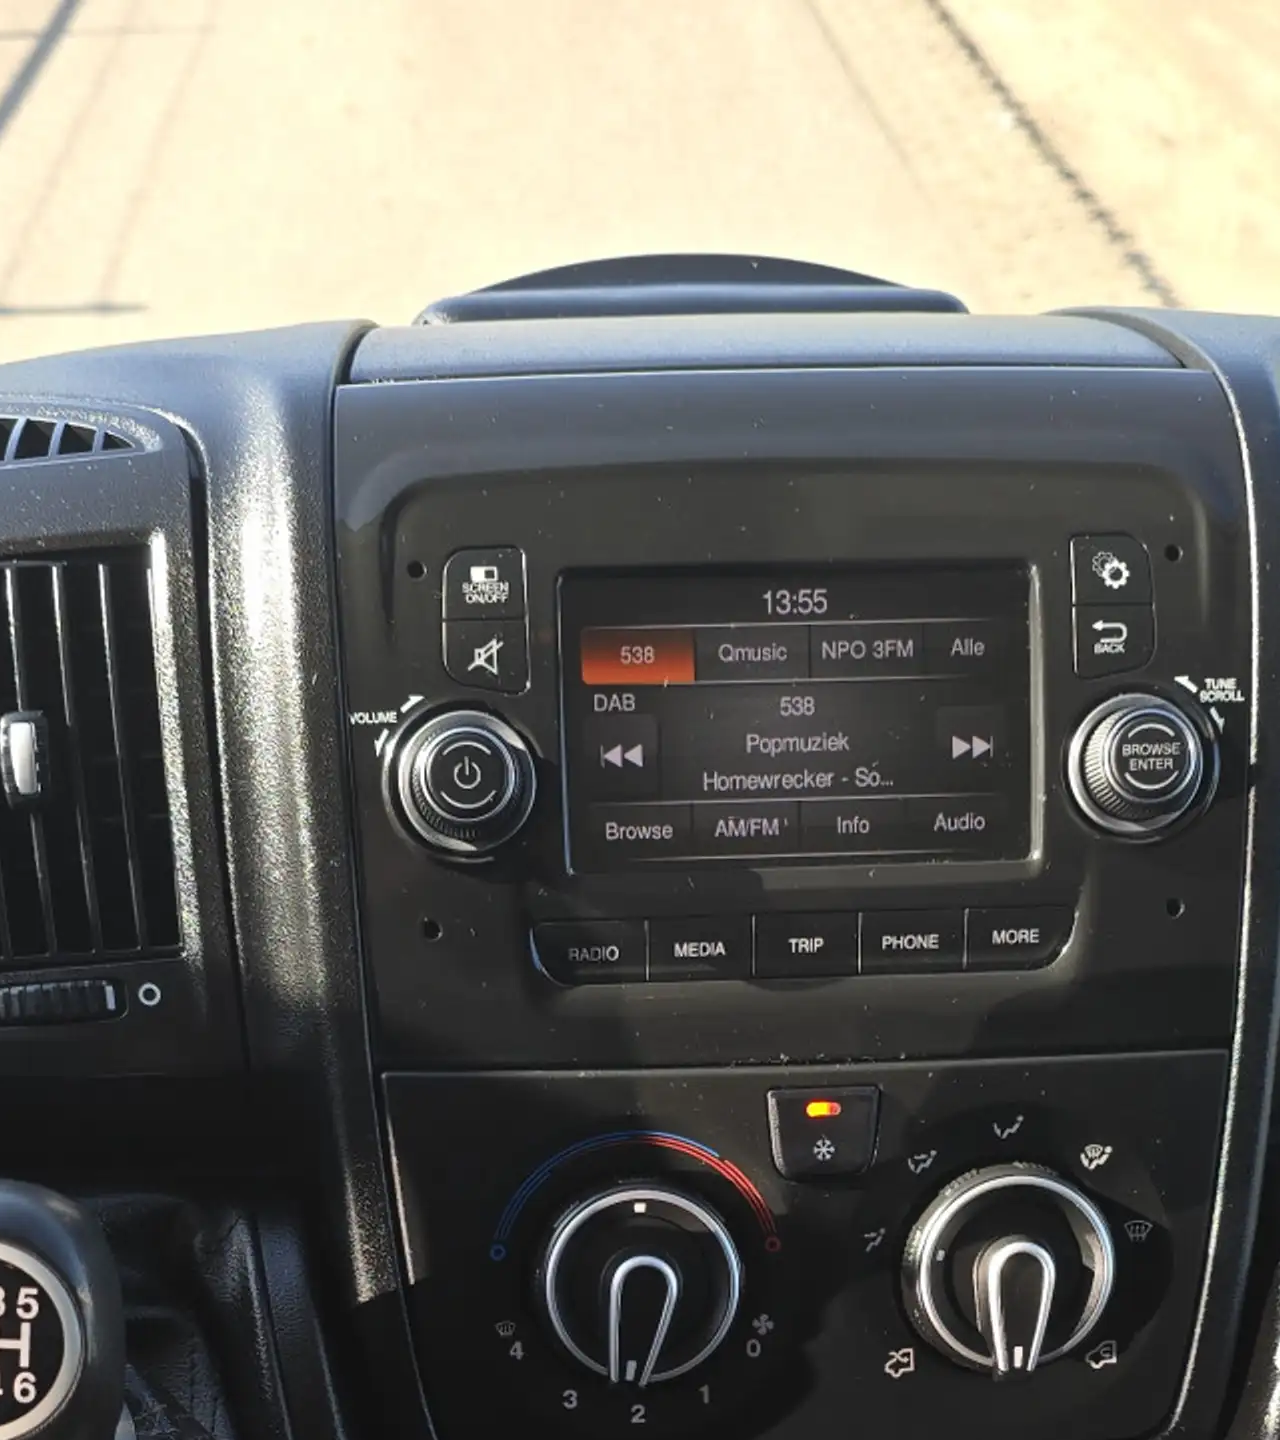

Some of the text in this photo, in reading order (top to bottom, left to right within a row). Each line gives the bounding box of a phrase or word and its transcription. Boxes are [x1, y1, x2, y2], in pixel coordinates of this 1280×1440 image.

[462, 582, 510, 594] SCREEN
[465, 593, 508, 605] ON/OFF
[763, 589, 828, 615] 13:55
[620, 646, 655, 665] 538
[718, 642, 788, 663] Qmusic
[821, 639, 914, 660] NPO 3FM
[950, 637, 986, 656] Alle
[1094, 641, 1126, 654] BACK
[1203, 677, 1237, 690] TUNE
[593, 693, 636, 712] DAB
[1199, 688, 1246, 703] SCROLL
[780, 696, 815, 716] 538
[349, 711, 398, 725] VOLUME
[746, 732, 850, 757] Popmuziek
[1121, 742, 1181, 757] BROWSE
[1128, 757, 1174, 771] ENTER
[702, 767, 834, 792] Homewrecker
[605, 821, 673, 840] Browse
[714, 817, 780, 838] AM/FM
[836, 816, 870, 835] Info
[933, 812, 986, 832] Audio
[788, 938, 824, 954] TRIP
[881, 934, 940, 950] PHONE
[991, 929, 1040, 945] MORE
[568, 945, 620, 962] RADIO
[673, 942, 726, 958] MEDIA
[15, 1287, 40, 1320] 5
[509, 1340, 525, 1360] 4
[746, 1338, 762, 1358] 0
[12, 1372, 37, 1404] 6
[698, 1384, 711, 1405] 1
[562, 1389, 579, 1410] 3
[630, 1404, 647, 1424] 2
